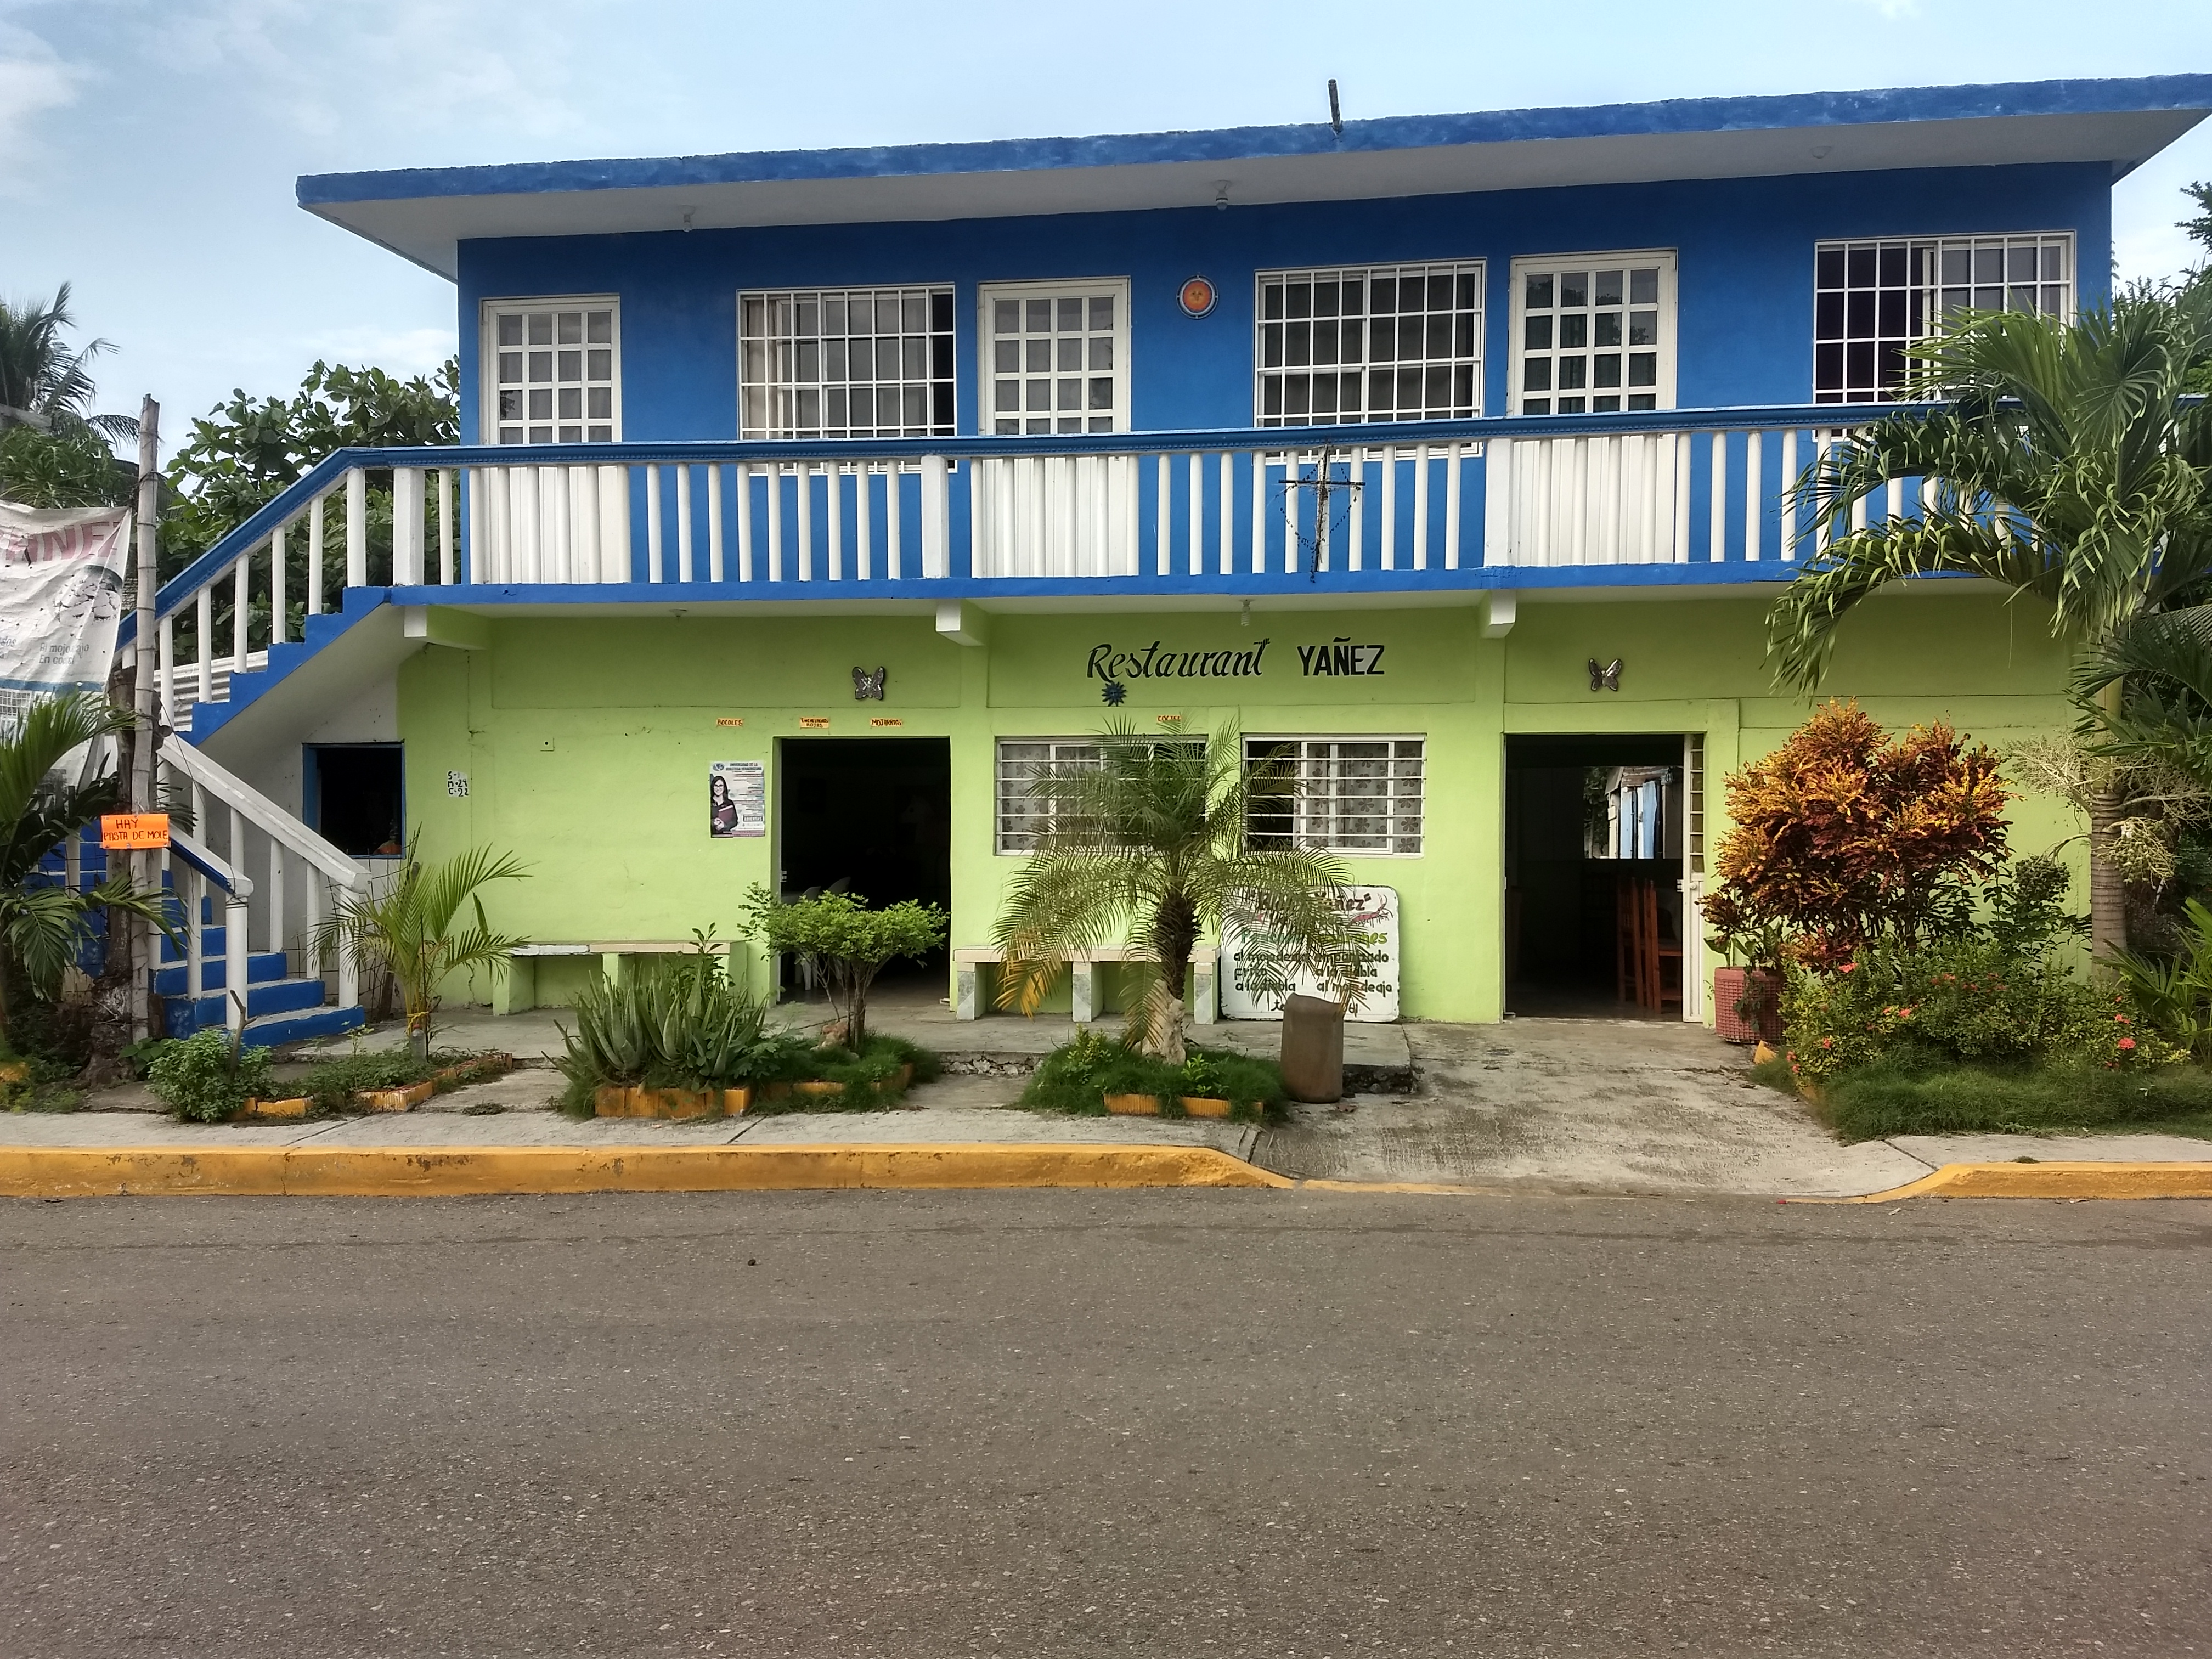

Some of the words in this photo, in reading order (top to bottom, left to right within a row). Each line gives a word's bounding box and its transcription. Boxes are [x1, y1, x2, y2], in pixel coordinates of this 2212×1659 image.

[1086, 637, 1271, 682] Restaurant
[1296, 636, 1385, 676] YAÑEZ
[116, 819, 138, 830] HAY
[104, 831, 128, 842] PASTA
[132, 831, 144, 840] DE
[147, 830, 168, 840] MOLE
[1316, 979, 1329, 992] al
